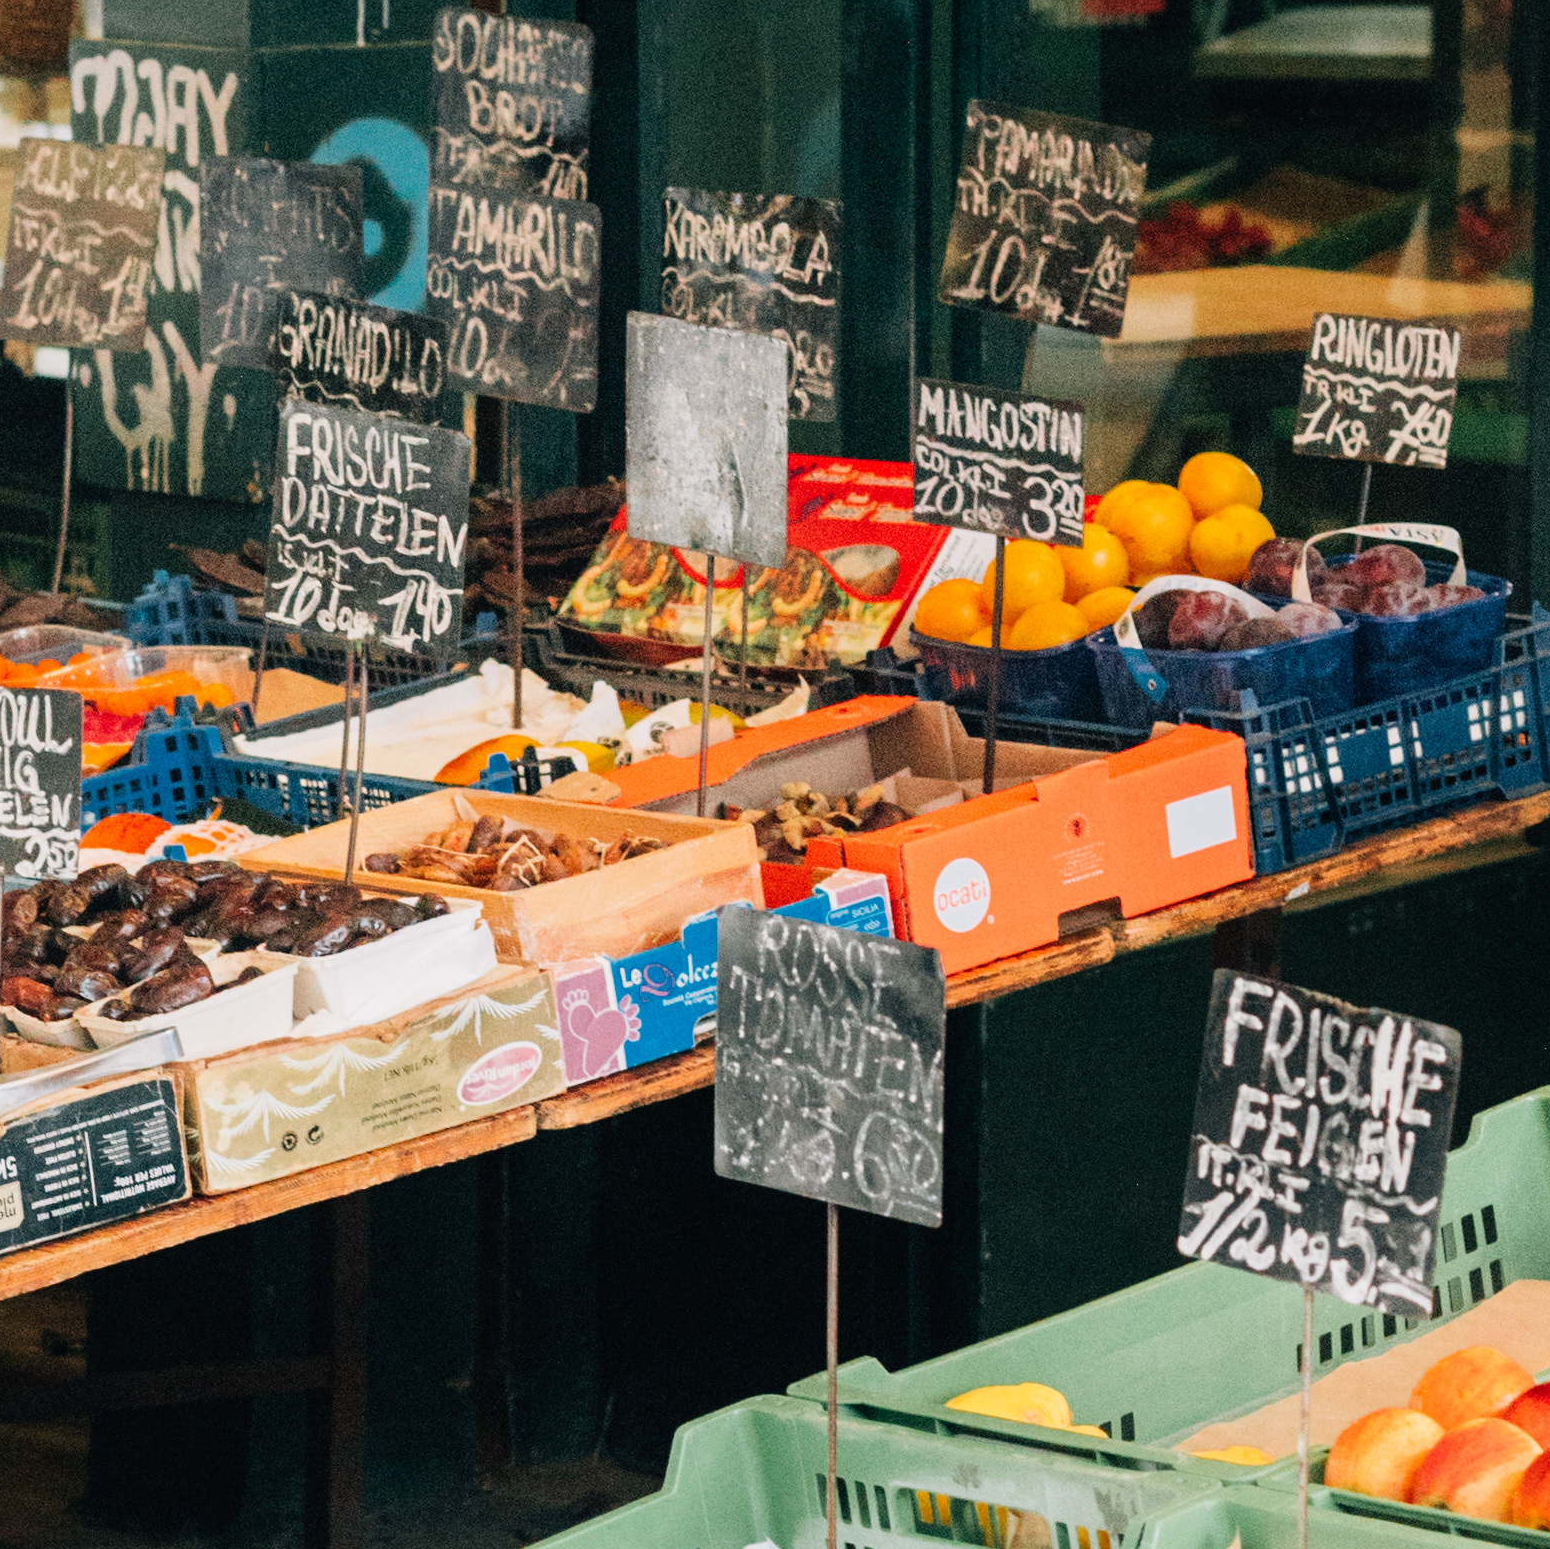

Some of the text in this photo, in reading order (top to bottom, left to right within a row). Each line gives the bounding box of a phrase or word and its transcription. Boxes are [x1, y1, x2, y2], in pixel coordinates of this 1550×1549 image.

[287, 412, 432, 495] FRISCHE
[916, 385, 1085, 461] MANGOSTIN
[937, 879, 988, 912] ocati
[1221, 975, 1448, 1128] FRISCHE
[1228, 1083, 1416, 1194] FEIGEN
